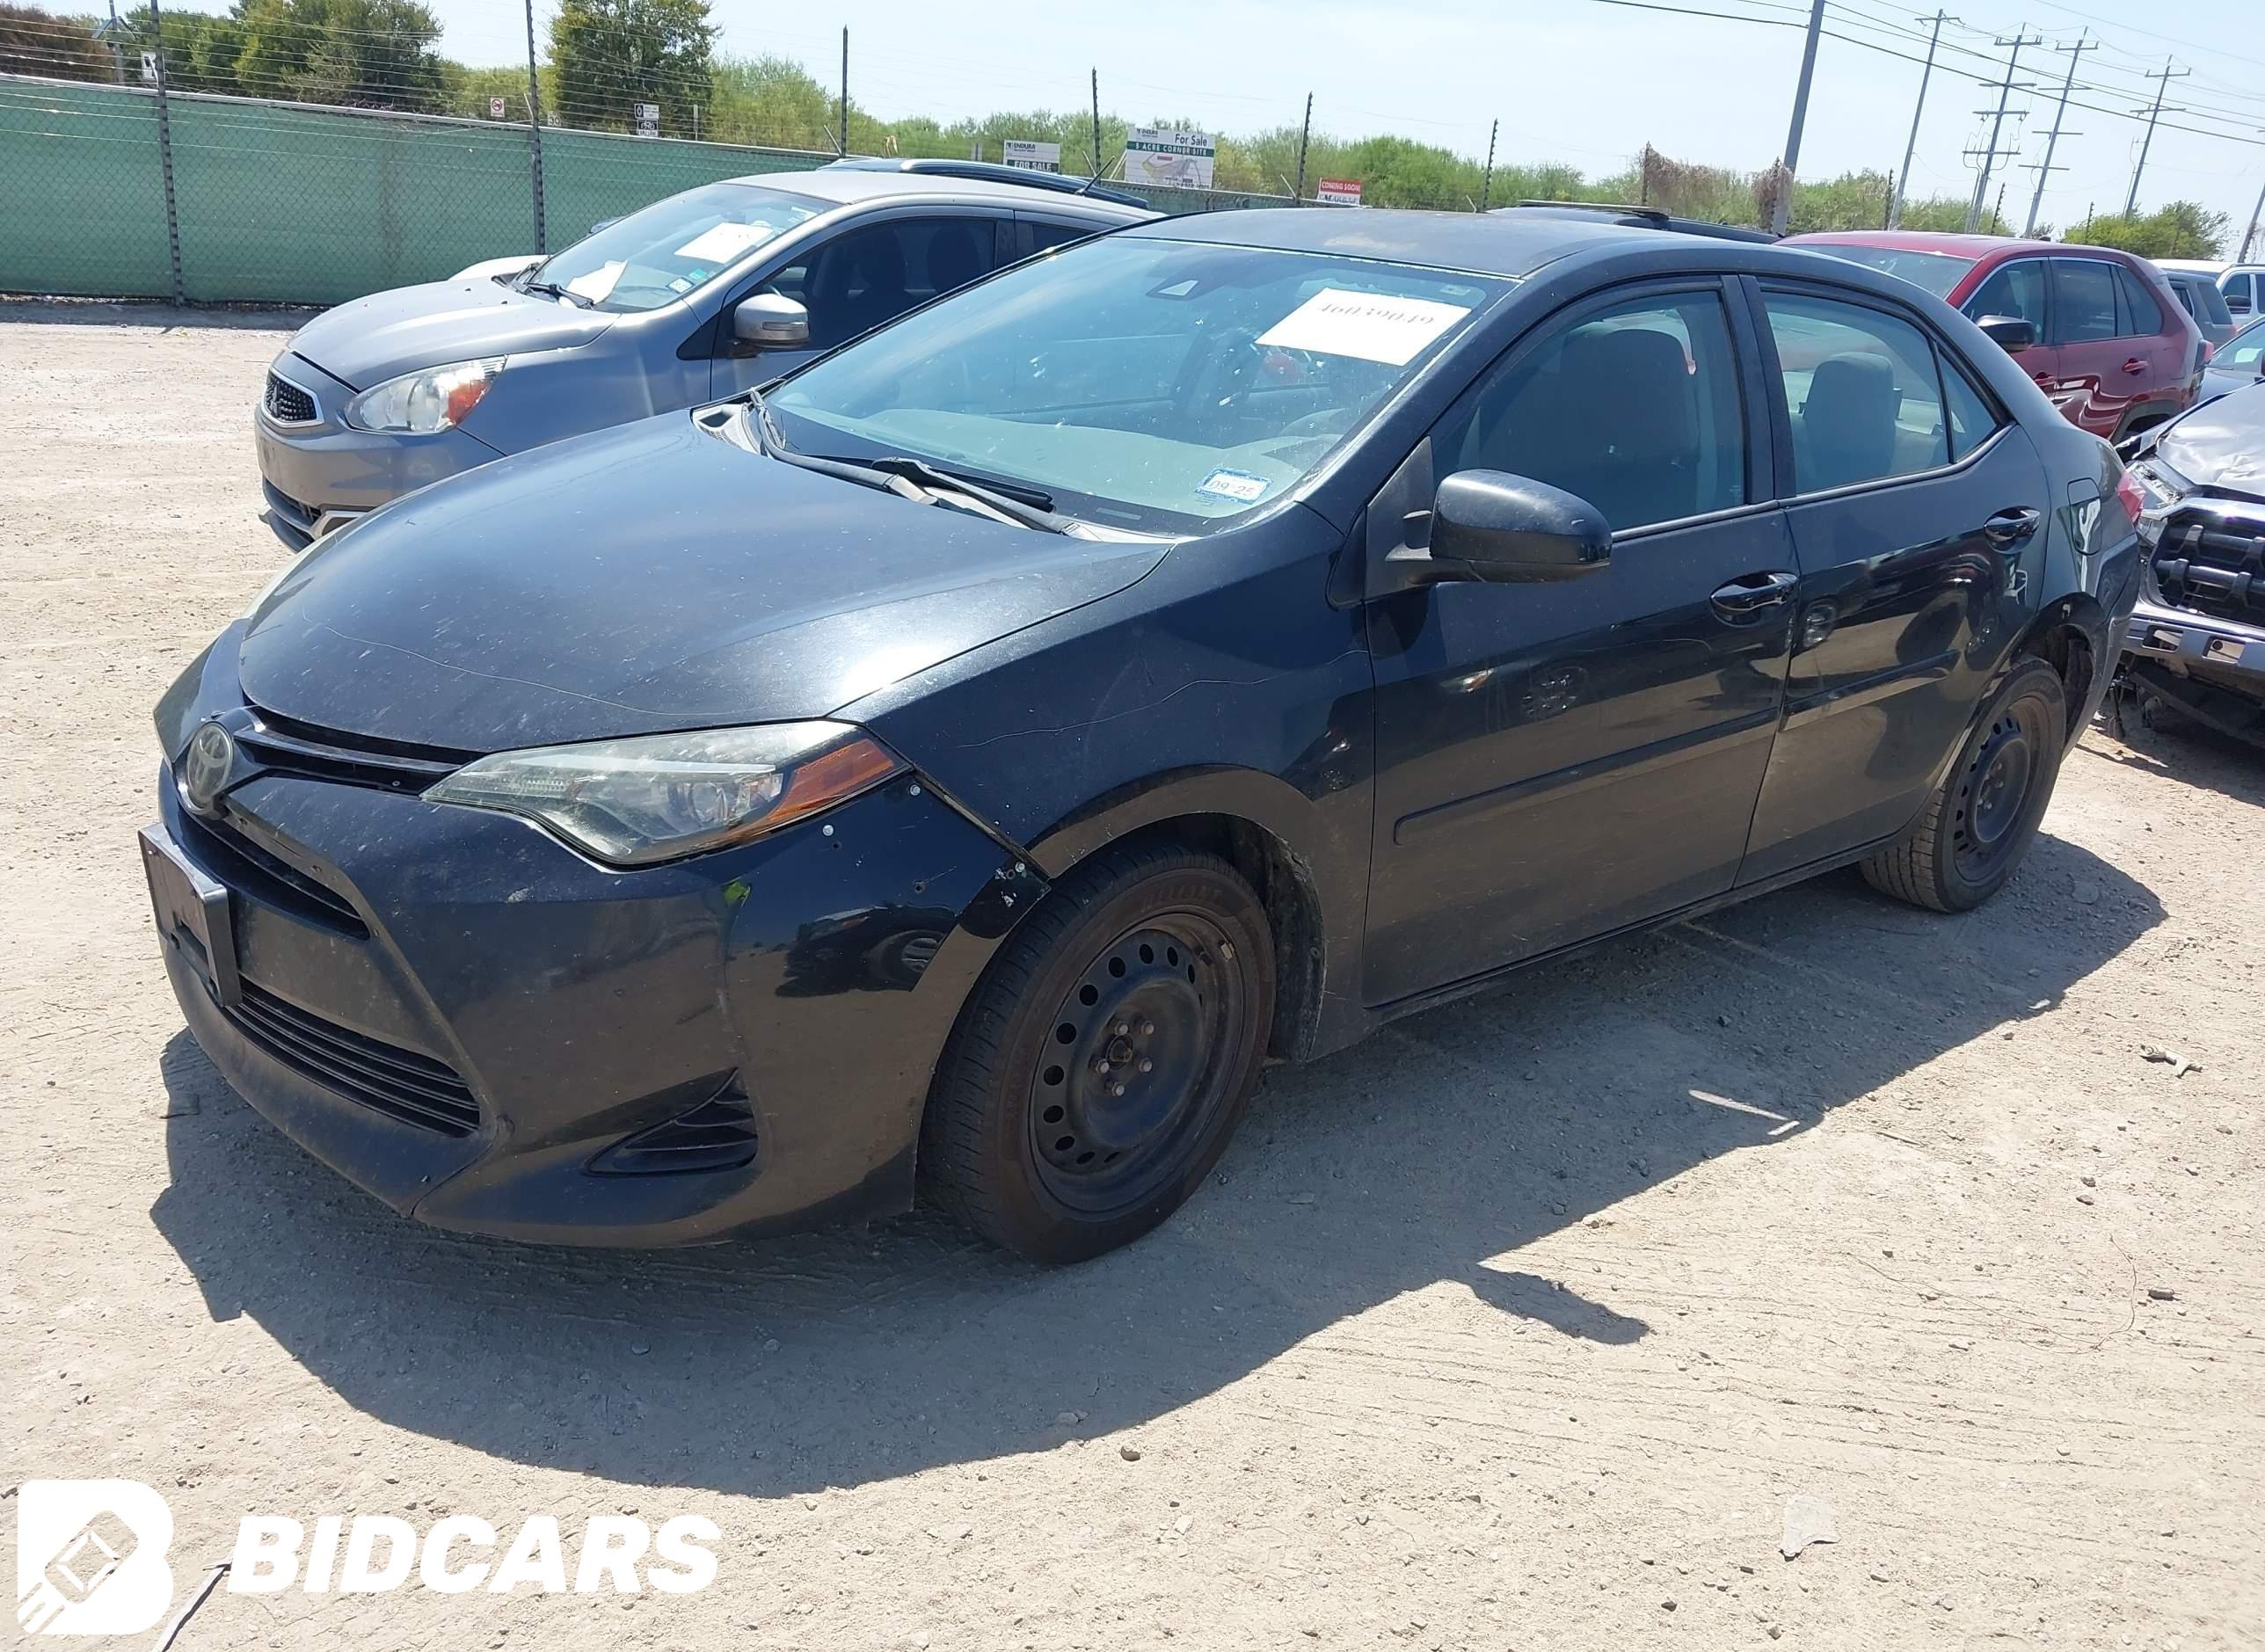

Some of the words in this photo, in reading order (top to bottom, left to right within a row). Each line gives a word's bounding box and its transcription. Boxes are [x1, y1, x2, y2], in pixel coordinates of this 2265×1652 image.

[1175, 134, 1189, 144] For
[1191, 134, 1208, 146] Sale
[1162, 145, 1191, 155] CORNER
[1014, 161, 1031, 170] FOR
[1031, 162, 1052, 172] SALE
[1322, 181, 1344, 190] COMING
